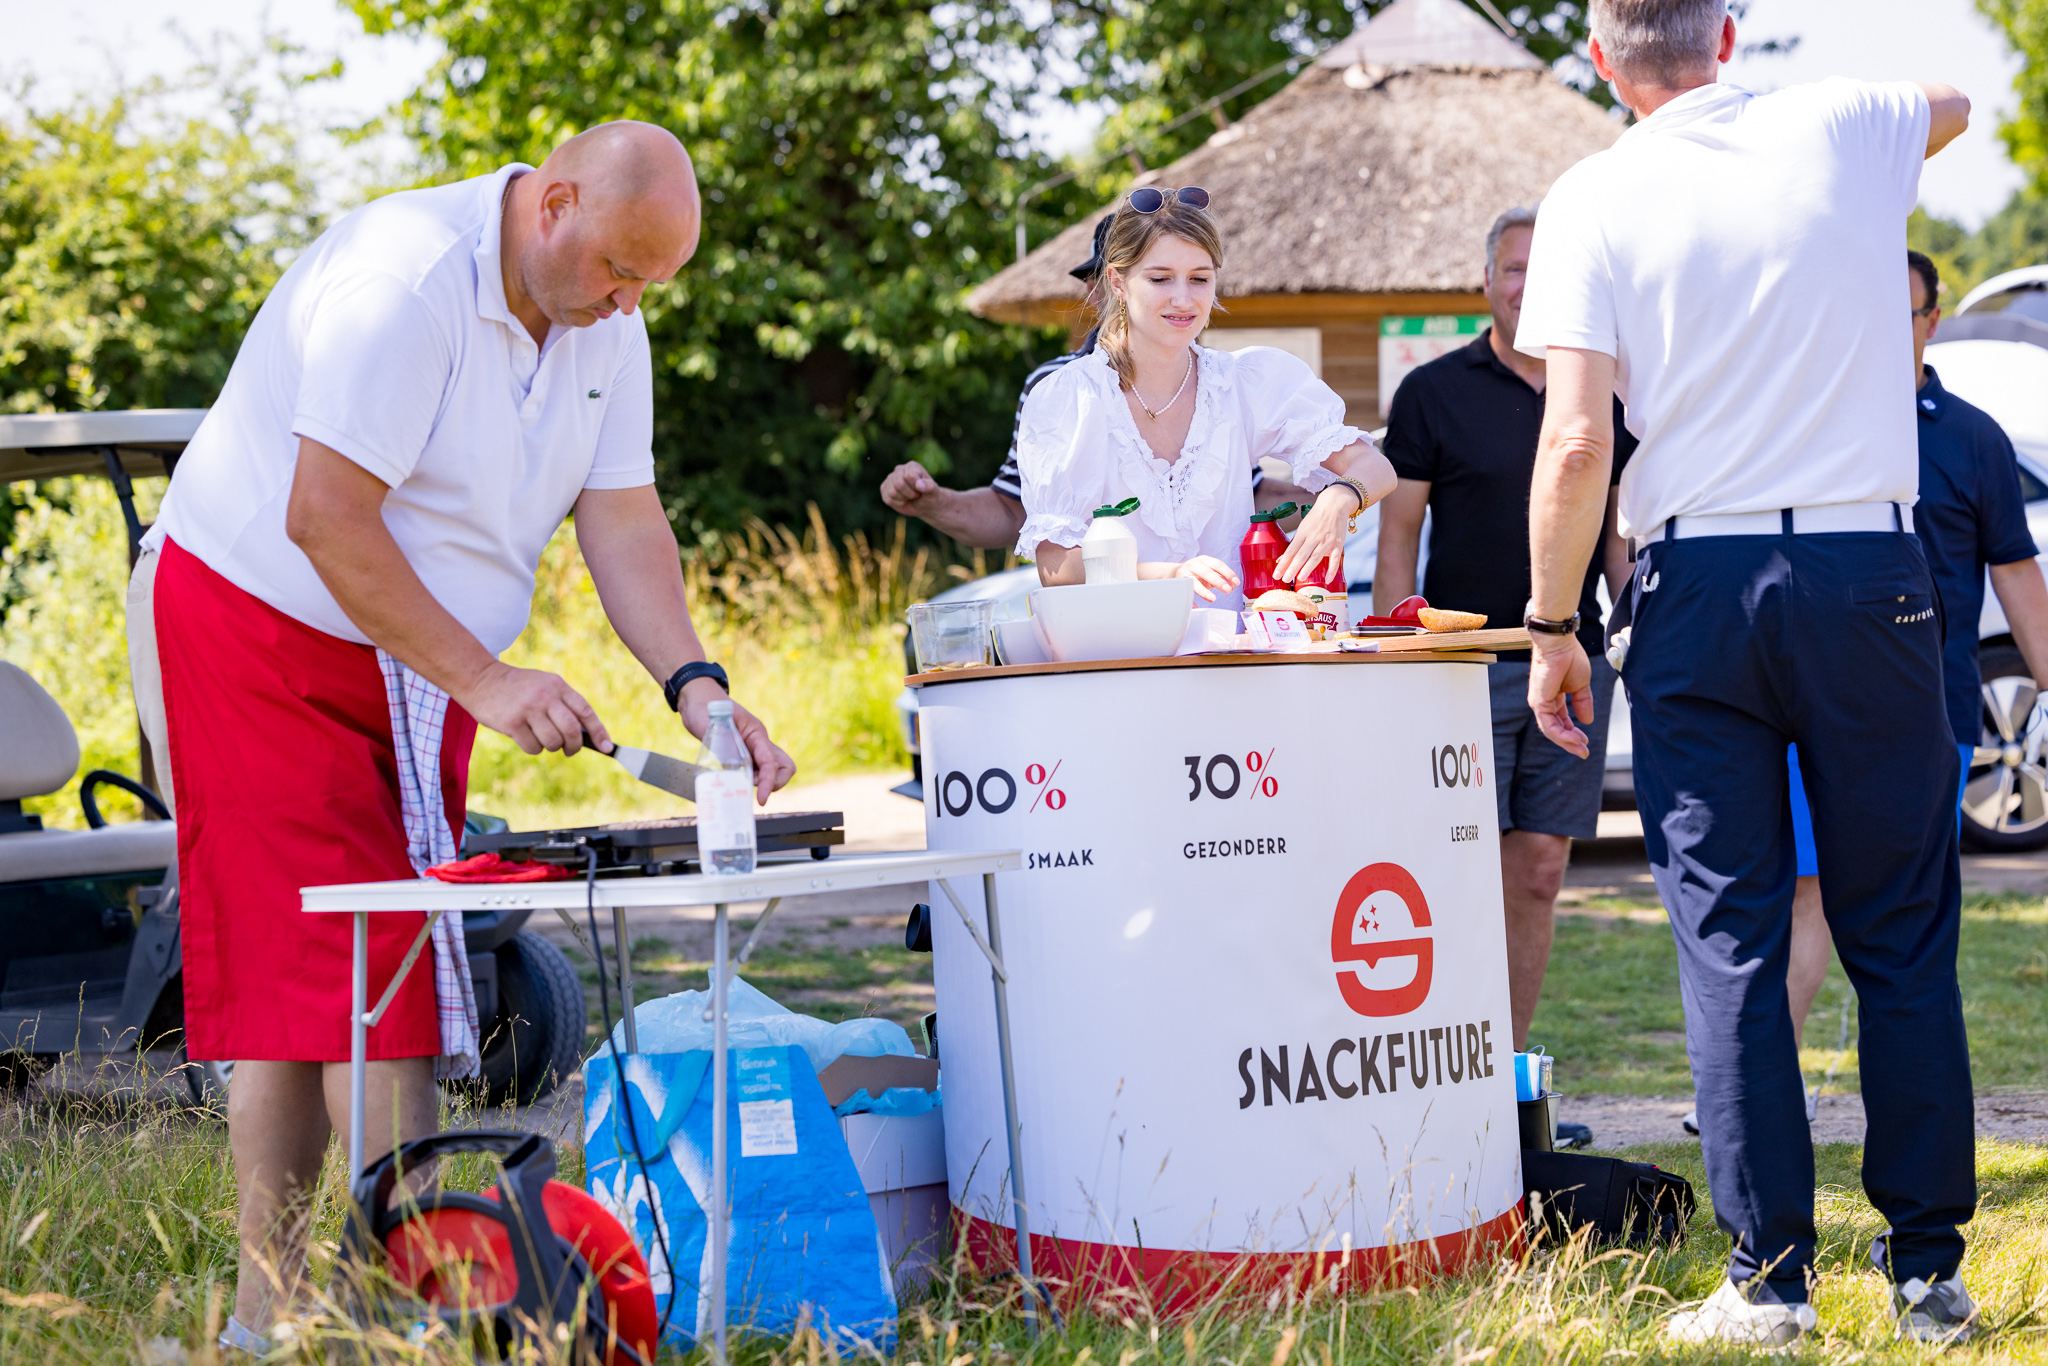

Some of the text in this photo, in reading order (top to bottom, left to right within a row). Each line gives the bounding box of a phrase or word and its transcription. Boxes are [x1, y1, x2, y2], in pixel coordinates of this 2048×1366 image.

[934, 758, 1067, 818] 100%
[1184, 747, 1279, 802] 30%
[1431, 740, 1483, 789] 100%
[1183, 837, 1287, 860] GEZONDERR
[1450, 824, 1479, 842] LECKERR
[1028, 848, 1094, 870] SMAAK
[1238, 1019, 1494, 1110] SNACKFUTURE
